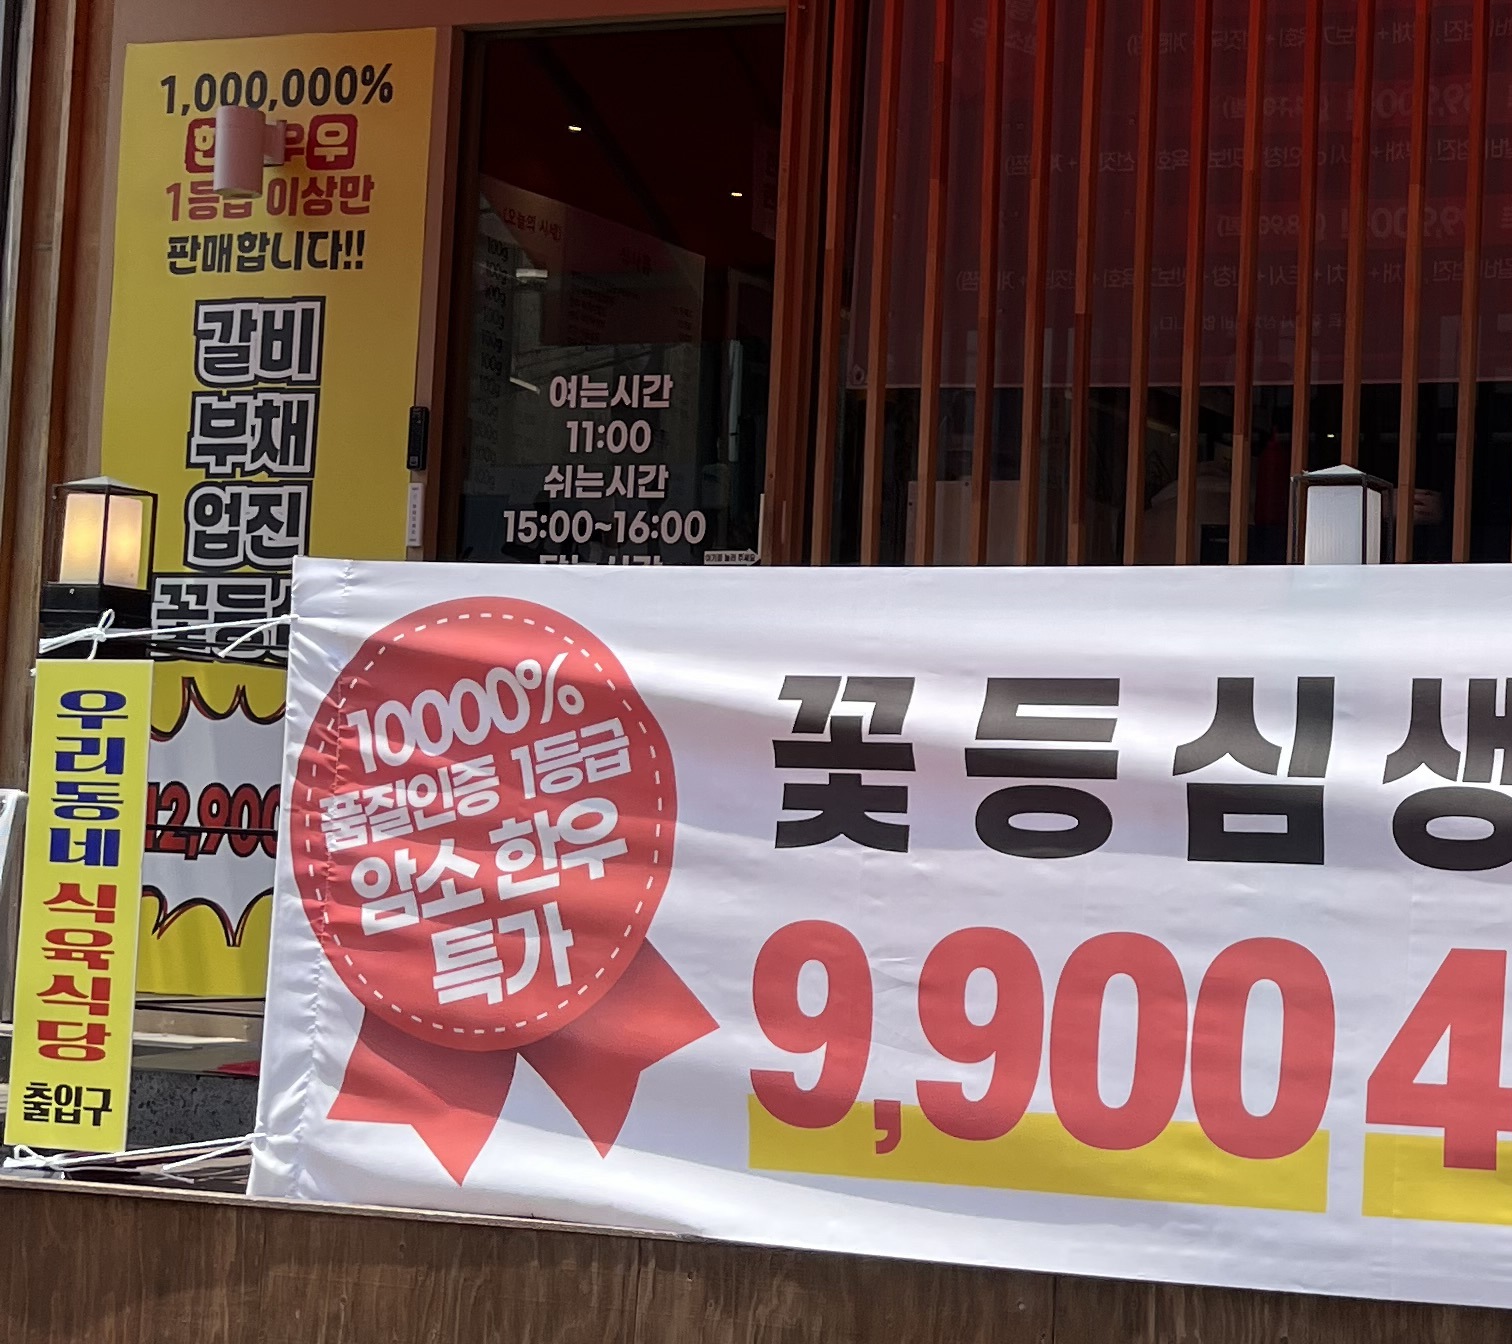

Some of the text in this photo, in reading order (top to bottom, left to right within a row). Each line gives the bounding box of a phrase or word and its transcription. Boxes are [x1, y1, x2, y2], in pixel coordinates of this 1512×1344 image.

[160, 63, 393, 116] 1,000,000%
[266, 175, 375, 216] 이상만
[167, 230, 365, 275] 판매합니다!!
[194, 296, 327, 387] 갈비
[186, 388, 320, 478] 부채
[550, 374, 674, 408] 여는시간
[543, 464, 669, 499] 쉬는시간
[566, 420, 651, 454] 11:00
[183, 480, 313, 572] 업진
[503, 510, 706, 544] 15:00~16:00
[346, 652, 584, 772] 10000%
[49, 689, 129, 867] 우리동네
[320, 718, 631, 852] 품질인증 1등급
[351, 798, 628, 935] 암소 한우
[36, 883, 118, 1063] 식육식당
[431, 902, 574, 1005] 특가
[749, 919, 1336, 1160] 9,900
[23, 1083, 113, 1126] 출입구
